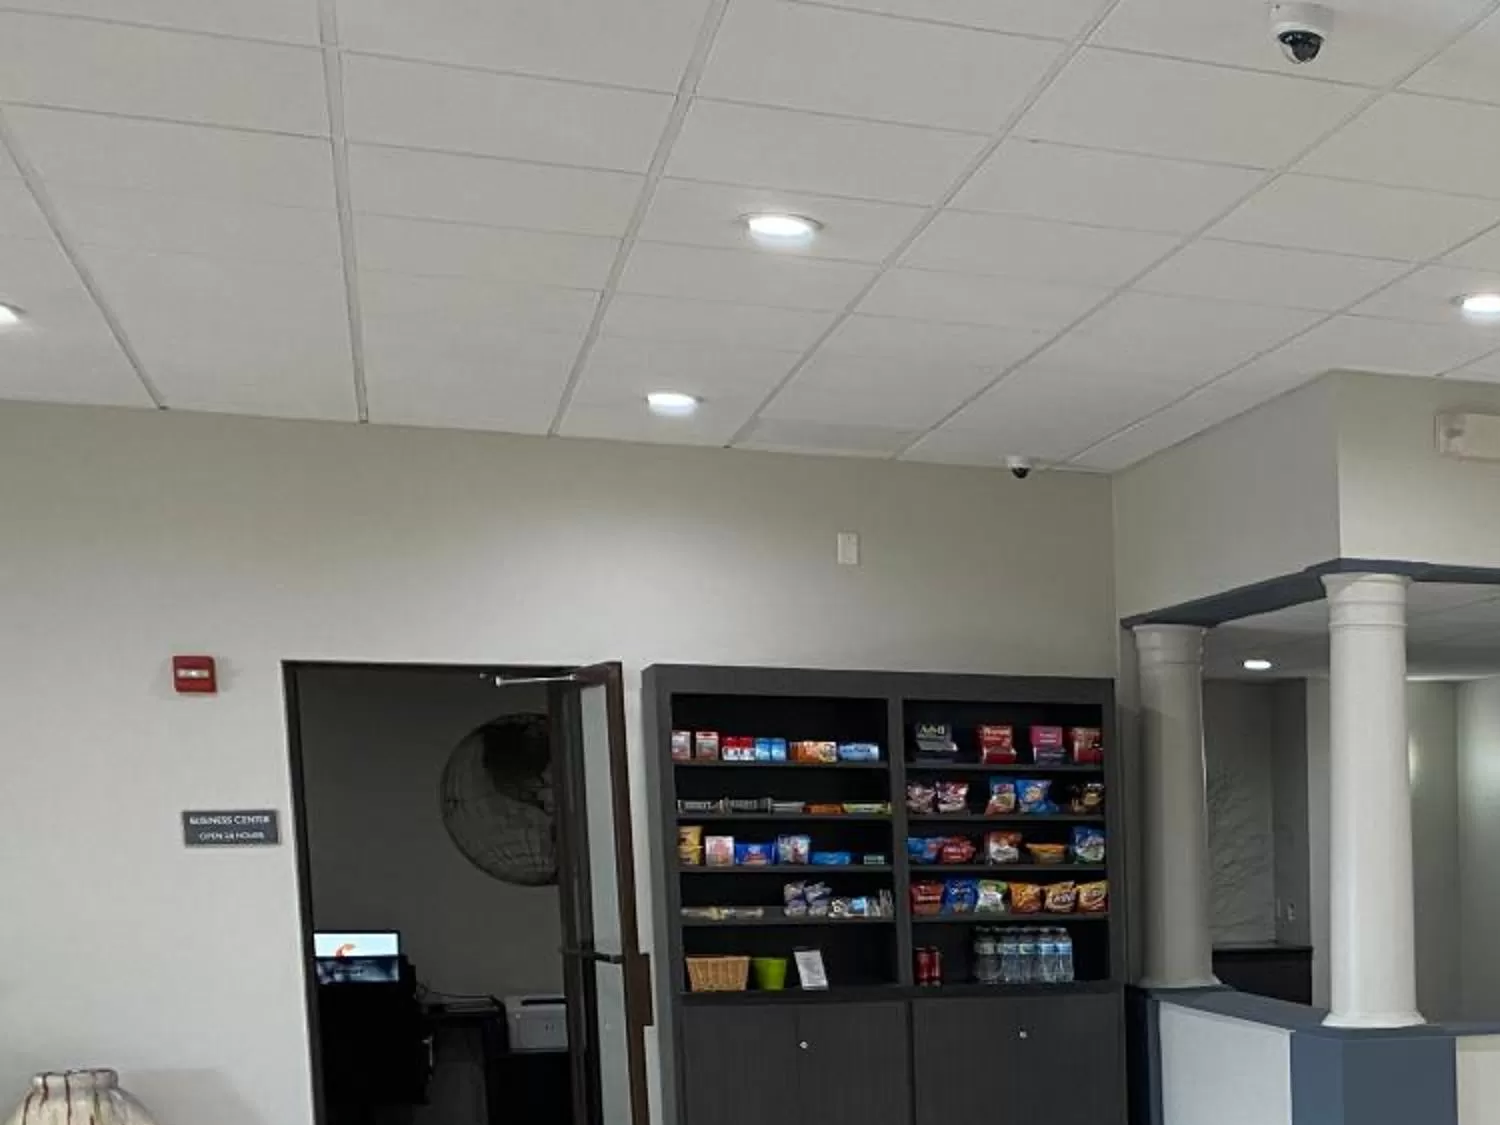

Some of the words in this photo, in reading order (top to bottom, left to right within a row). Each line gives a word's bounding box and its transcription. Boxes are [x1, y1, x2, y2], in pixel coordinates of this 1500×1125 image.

[189, 815, 232, 824] BUSINESS
[234, 815, 270, 824] CENTER
[199, 831, 223, 840] OPEN
